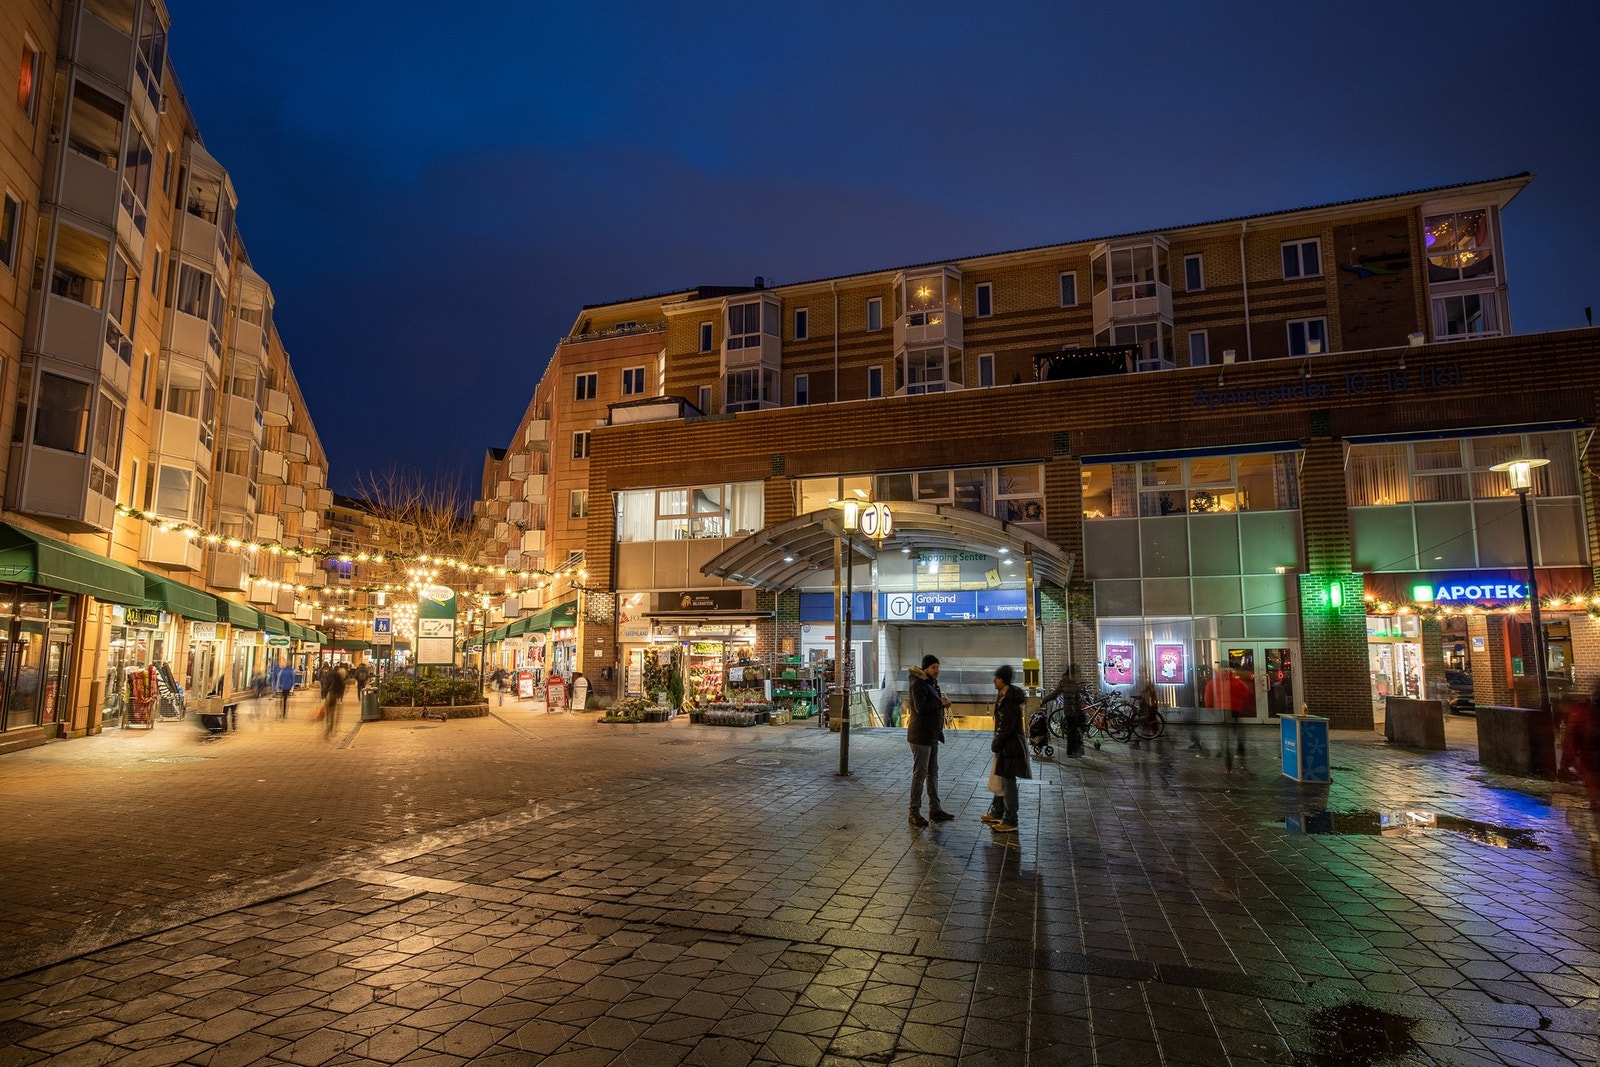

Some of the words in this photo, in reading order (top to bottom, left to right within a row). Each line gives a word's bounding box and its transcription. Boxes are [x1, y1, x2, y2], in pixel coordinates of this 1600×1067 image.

[1344, 373, 1368, 394] 10
[1386, 369, 1408, 392] 18
[1420, 362, 1462, 390] (16)
[865, 511, 875, 531] T
[883, 511, 890, 531] T
[917, 553, 958, 563] Shopping
[959, 552, 987, 562] Senter
[916, 593, 956, 604] Grønland
[1436, 584, 1524, 600] APOTEK
[896, 601, 905, 614] T
[997, 604, 1027, 612] Forretninge
[1162, 653, 1178, 662] 50%
